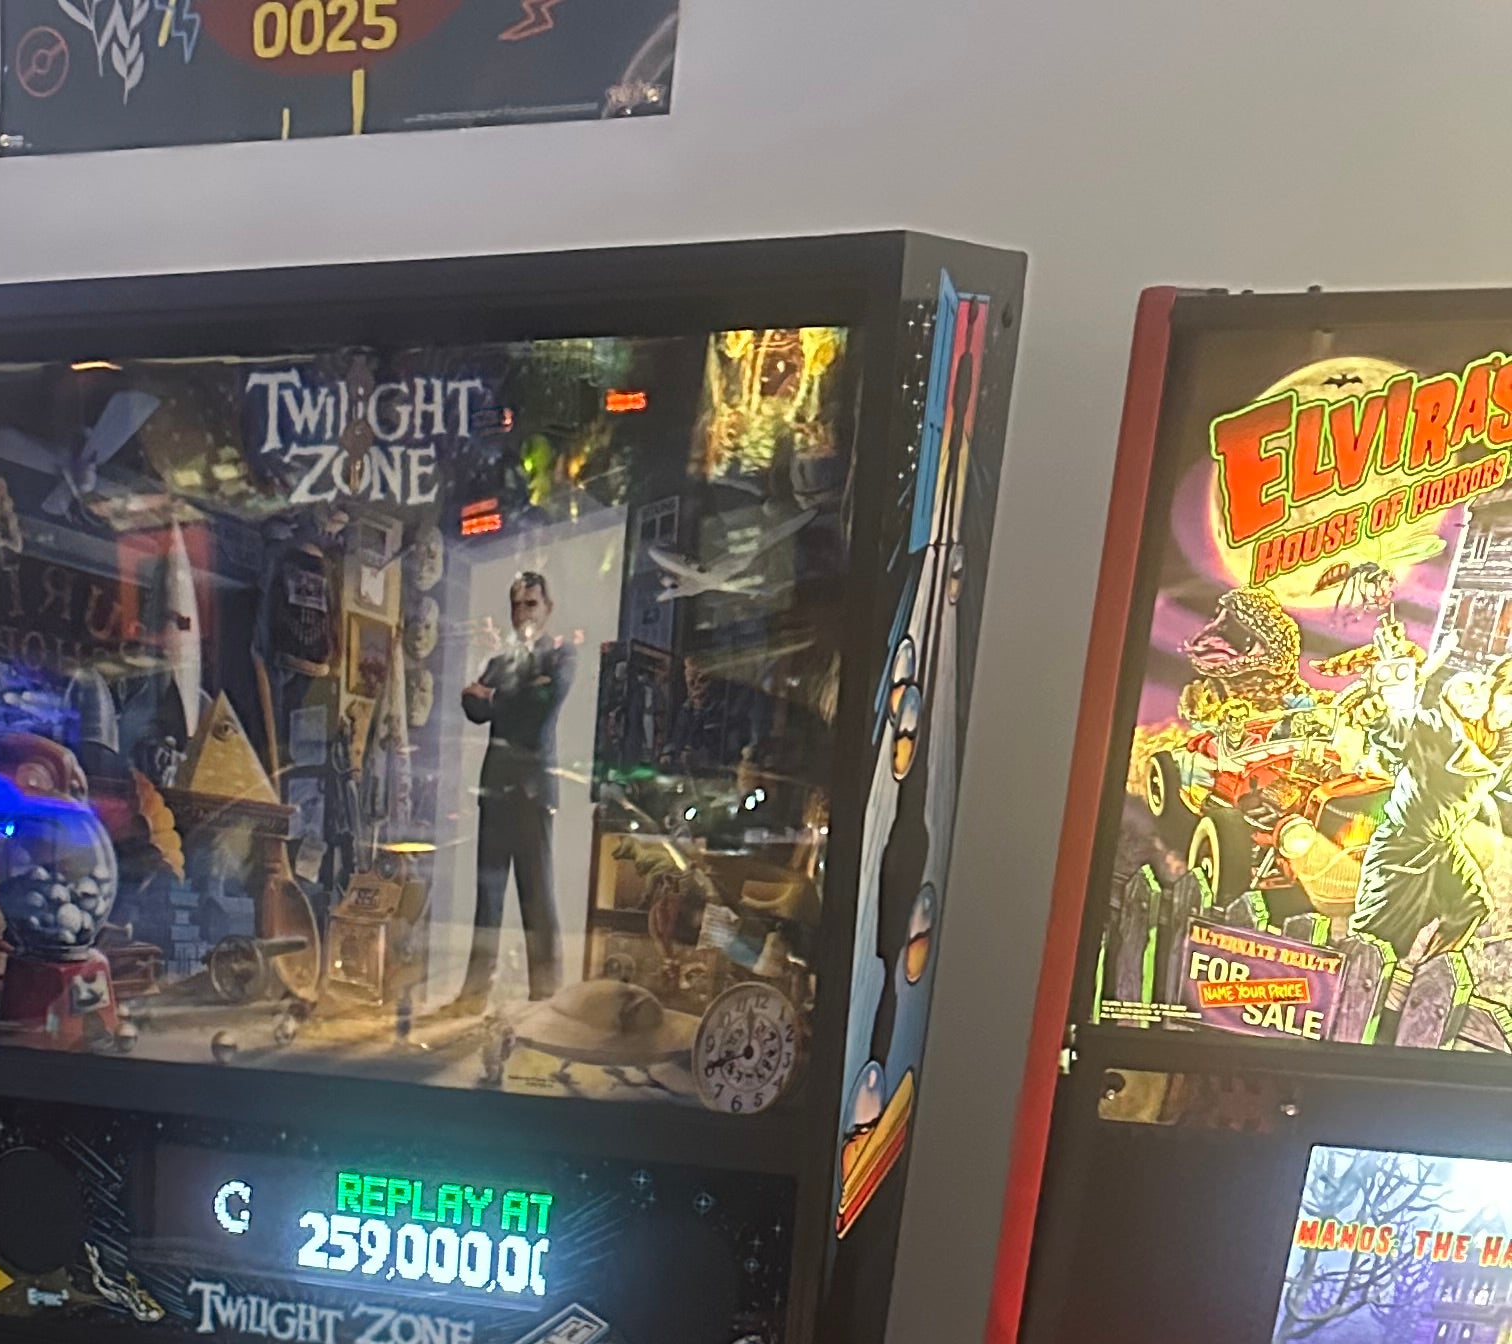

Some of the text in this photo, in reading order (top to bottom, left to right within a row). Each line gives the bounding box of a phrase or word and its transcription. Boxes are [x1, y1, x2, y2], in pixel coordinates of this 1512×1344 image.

[252, 0, 399, 59] 0025
[283, 441, 439, 505] ZONE
[1253, 453, 1508, 586] HOUSE OF HORRORS
[1190, 951, 1251, 984] FOR
[1202, 982, 1305, 1000] NAME YOUR PRICE
[1243, 1003, 1325, 1041] SALE
[213, 1179, 253, 1235] C
[337, 1171, 553, 1234] REPLAY AT
[1295, 1219, 1401, 1259] MANOS:
[1414, 1229, 1473, 1265] THE
